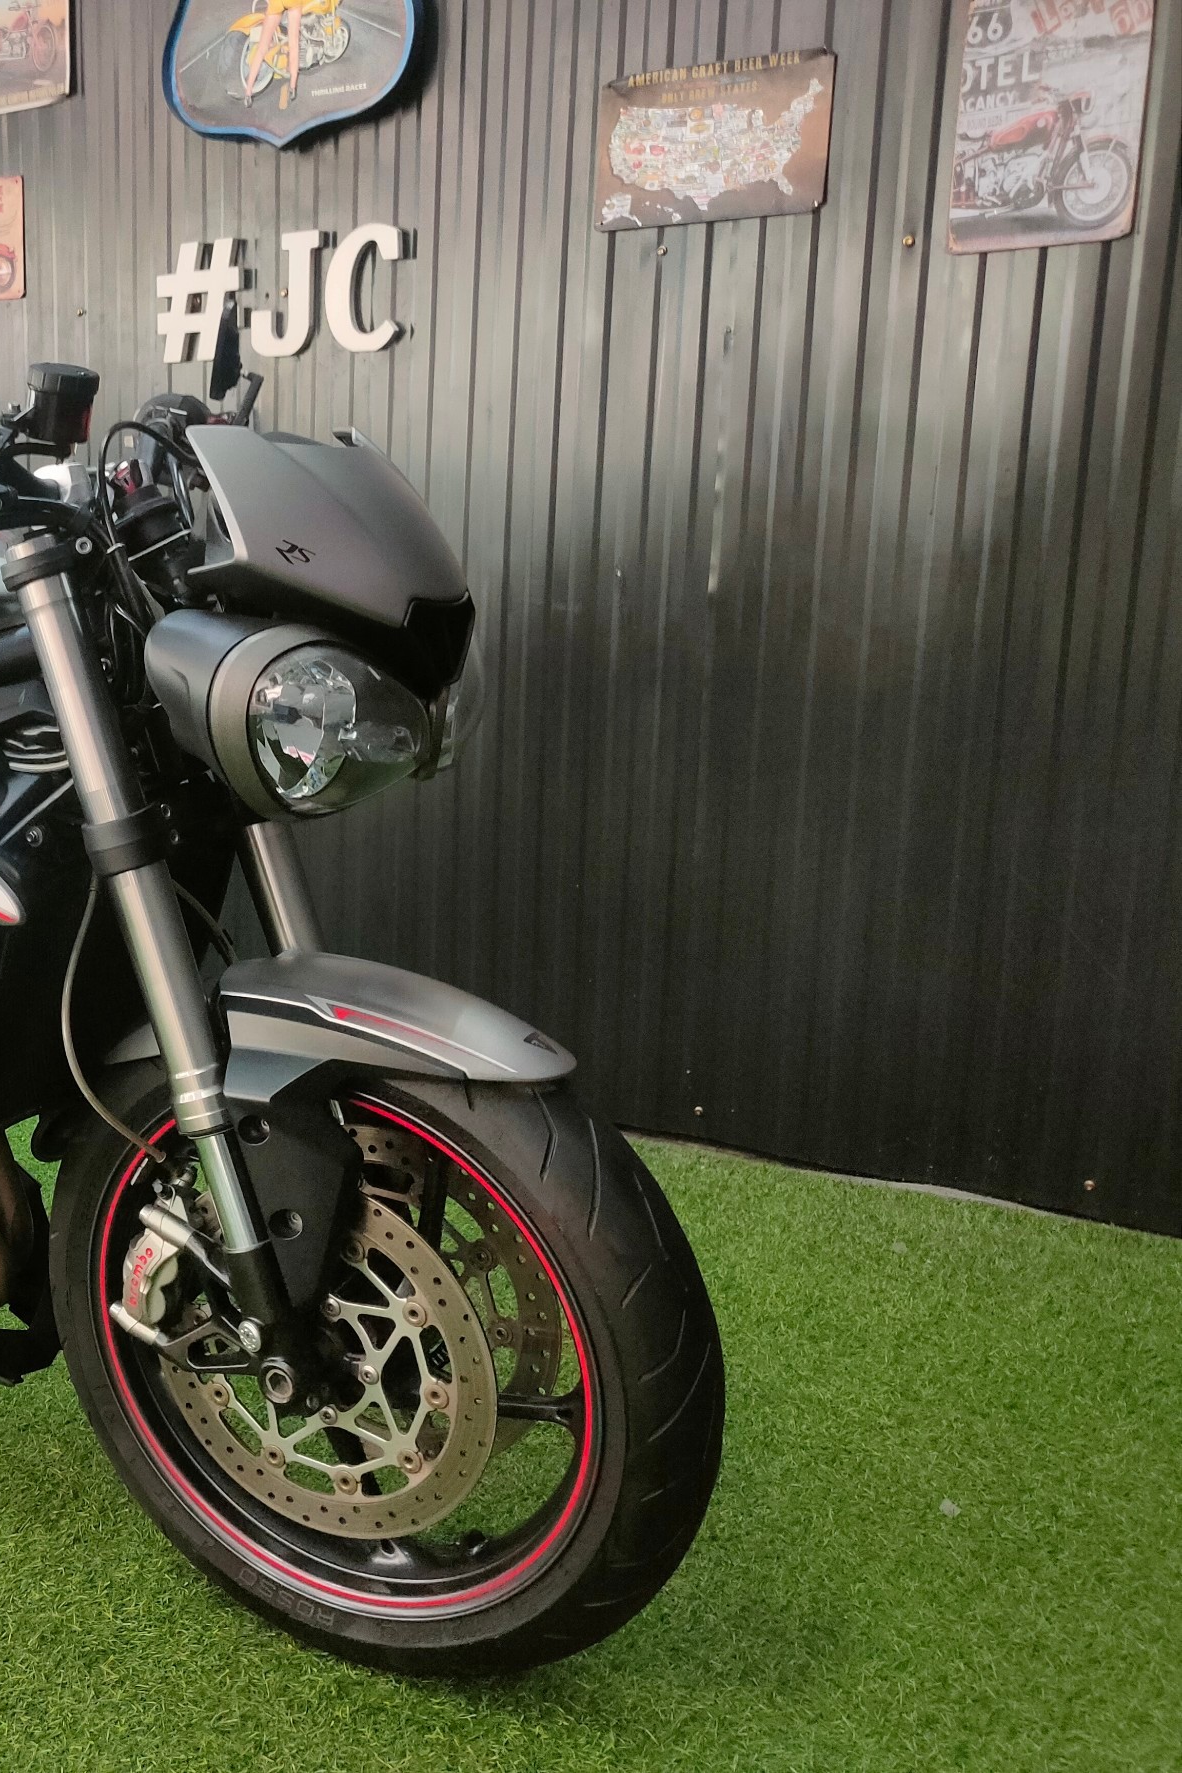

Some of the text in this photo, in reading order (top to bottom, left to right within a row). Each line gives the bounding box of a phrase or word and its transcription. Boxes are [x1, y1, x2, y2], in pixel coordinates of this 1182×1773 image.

[967, 12, 1004, 44] 66
[628, 67, 687, 88] AMERICAN
[734, 56, 763, 73] BEER
[768, 50, 801, 67] WEEK
[129, 1247, 154, 1307] brembo
[238, 1567, 337, 1628] ROSSO
